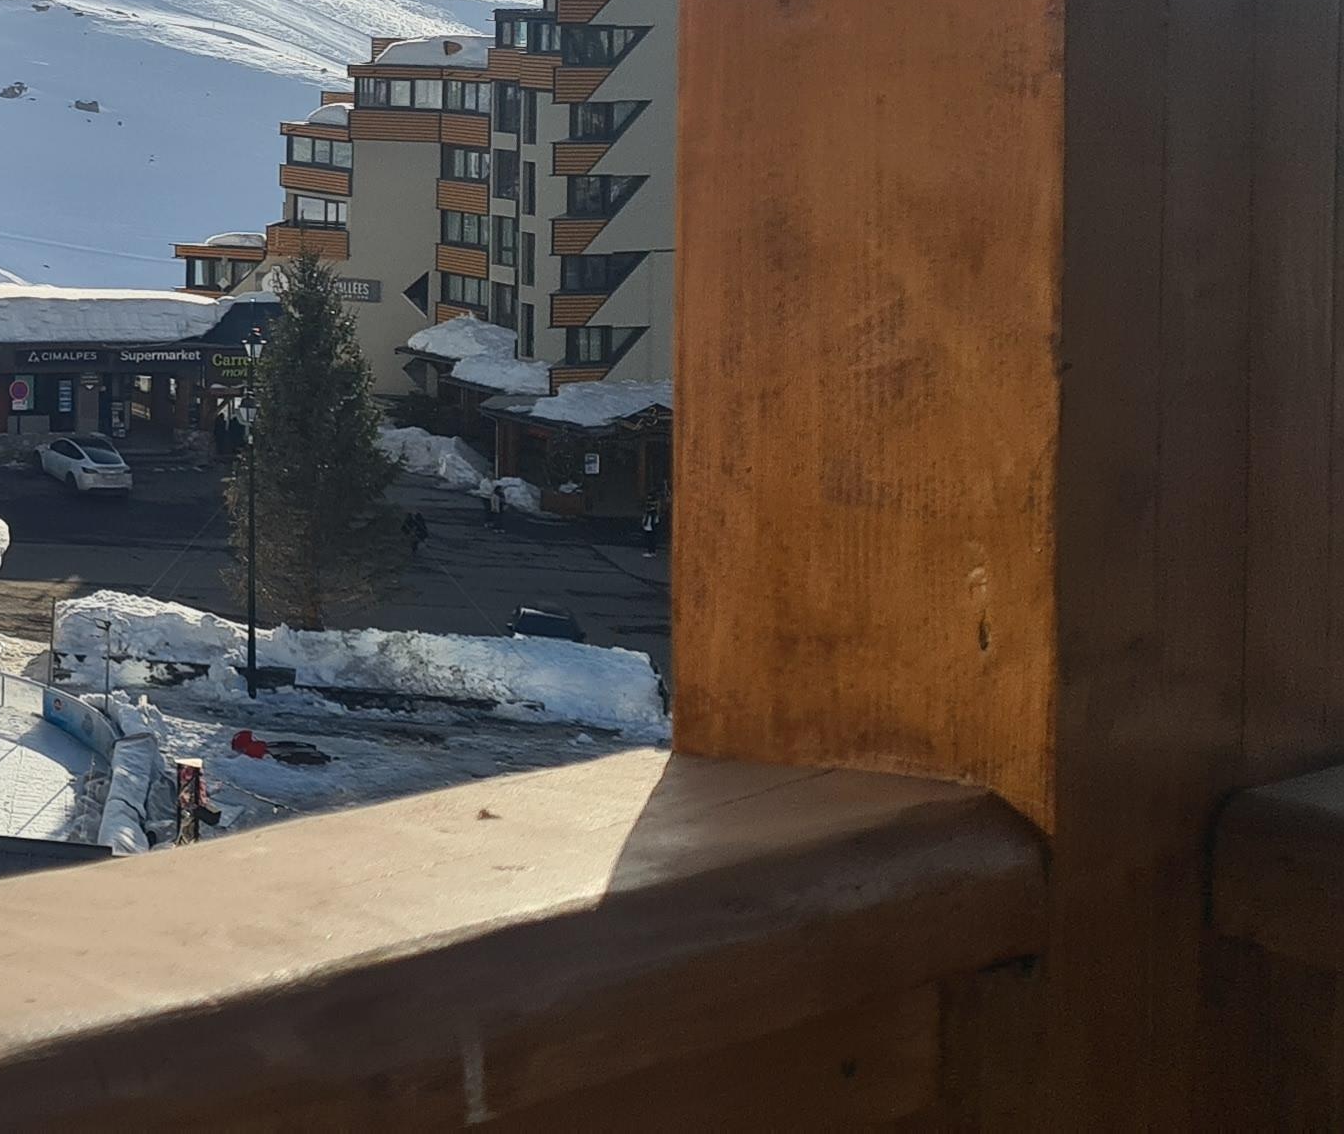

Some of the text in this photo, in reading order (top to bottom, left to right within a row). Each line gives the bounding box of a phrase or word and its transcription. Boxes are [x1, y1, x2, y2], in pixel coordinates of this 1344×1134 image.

[333, 280, 369, 295] ALLEES
[41, 351, 97, 361] CIMALPES
[119, 349, 201, 363] Supermarket
